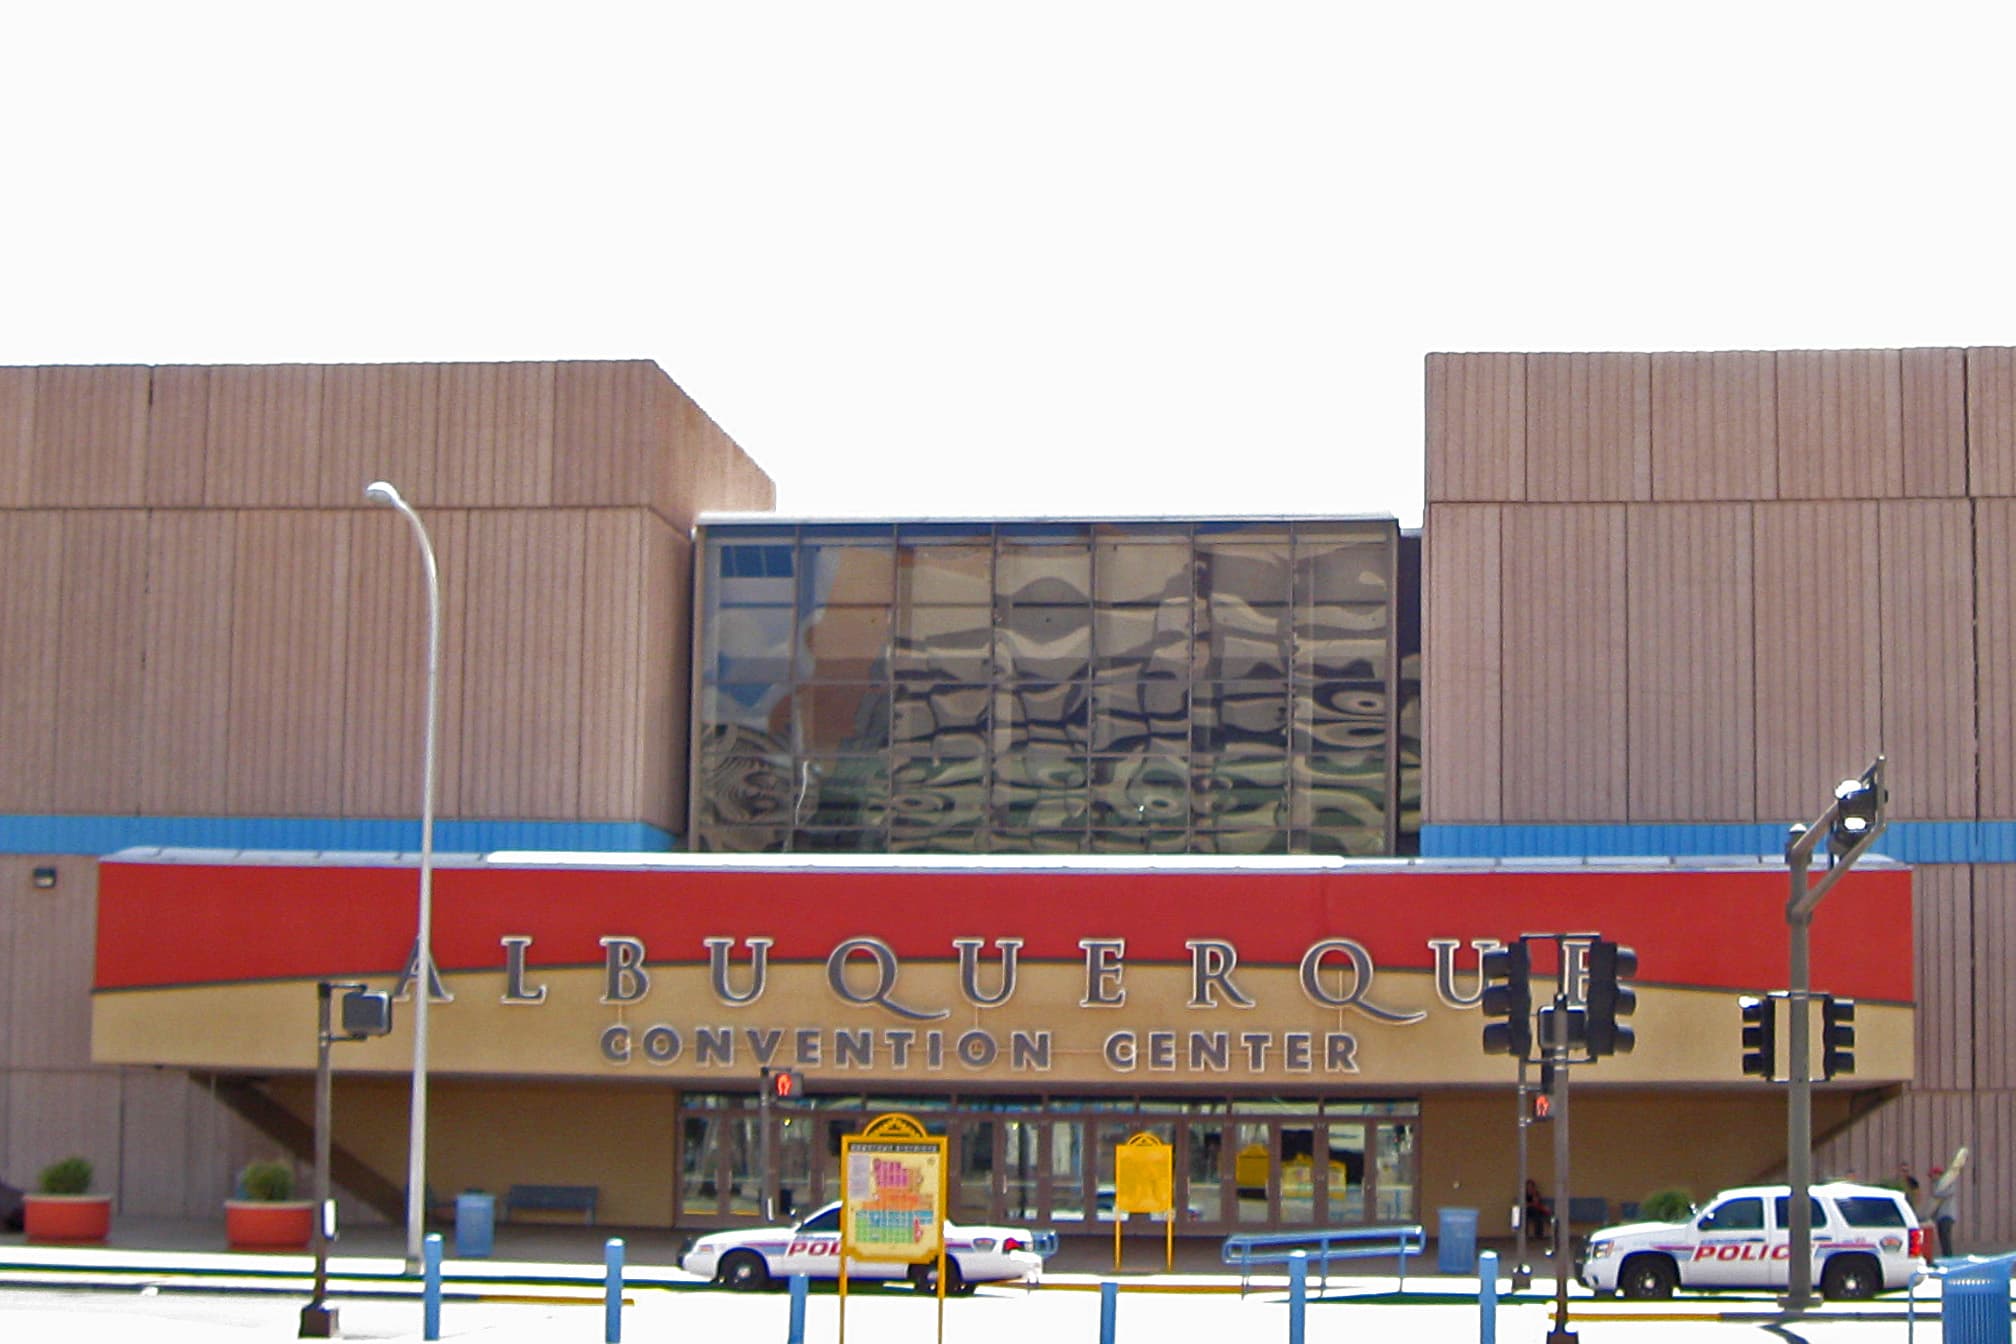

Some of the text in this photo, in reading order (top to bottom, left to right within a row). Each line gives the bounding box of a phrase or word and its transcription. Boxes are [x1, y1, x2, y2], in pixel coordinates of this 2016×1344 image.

[600, 1024, 1360, 1074] CONVENTION CENTER
[787, 1242, 842, 1256] POL
[1693, 1244, 1791, 1262] POLIC
